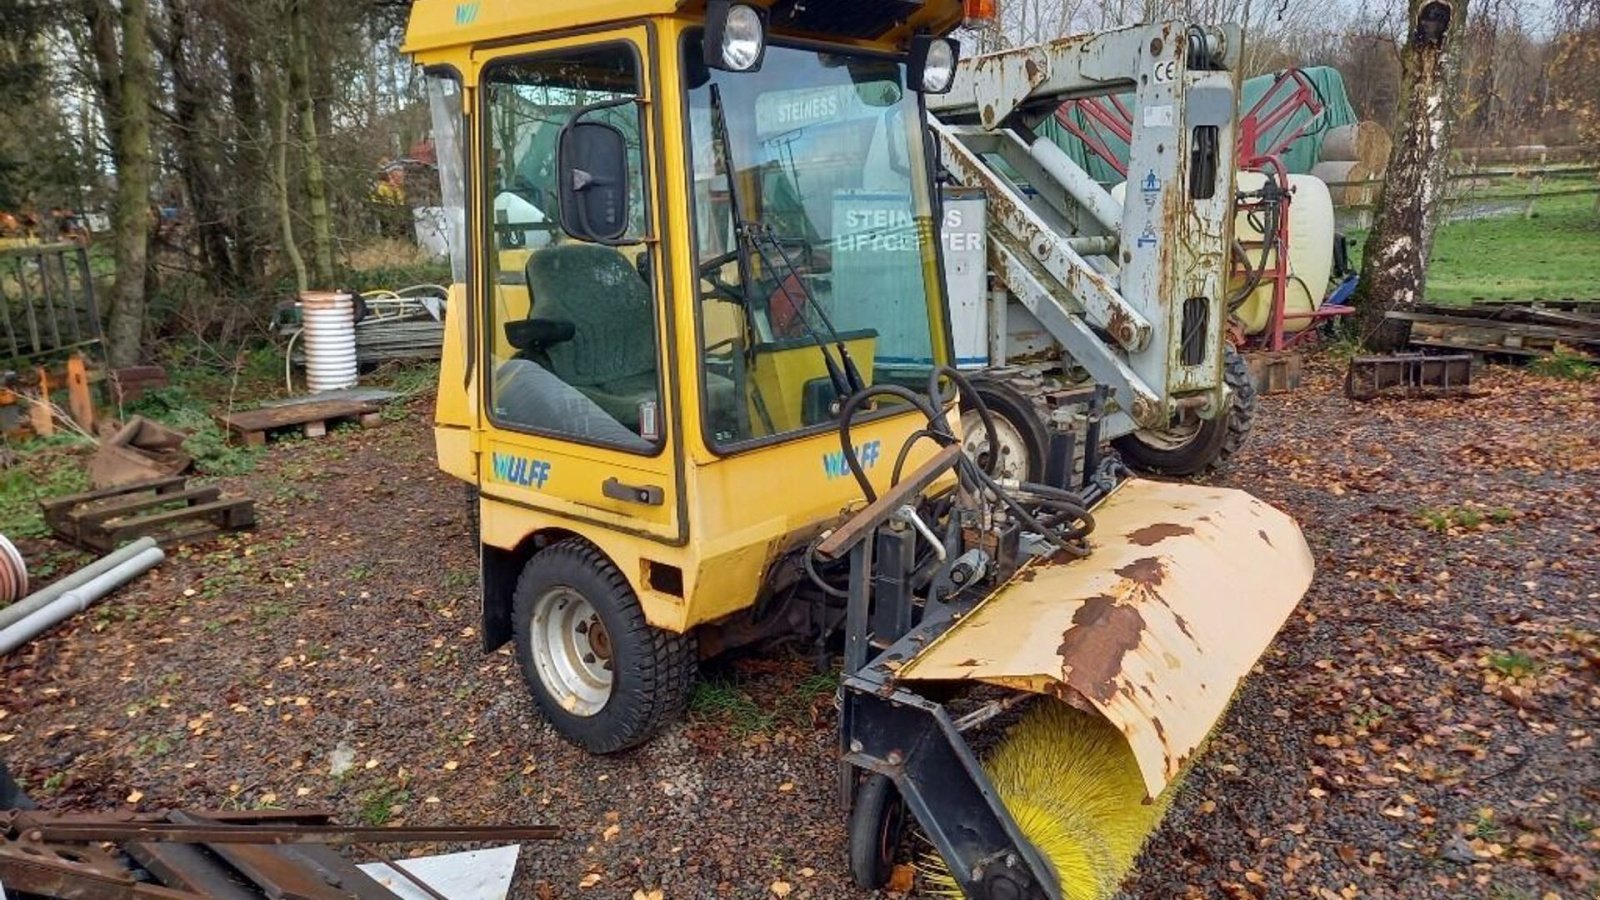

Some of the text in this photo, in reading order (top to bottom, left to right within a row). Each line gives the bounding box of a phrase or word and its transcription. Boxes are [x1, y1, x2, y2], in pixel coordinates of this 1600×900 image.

[1155, 61, 1175, 82] CE
[778, 97, 837, 122] STEINESS
[847, 209, 962, 228] STEINS
[493, 452, 551, 489] WULFF
